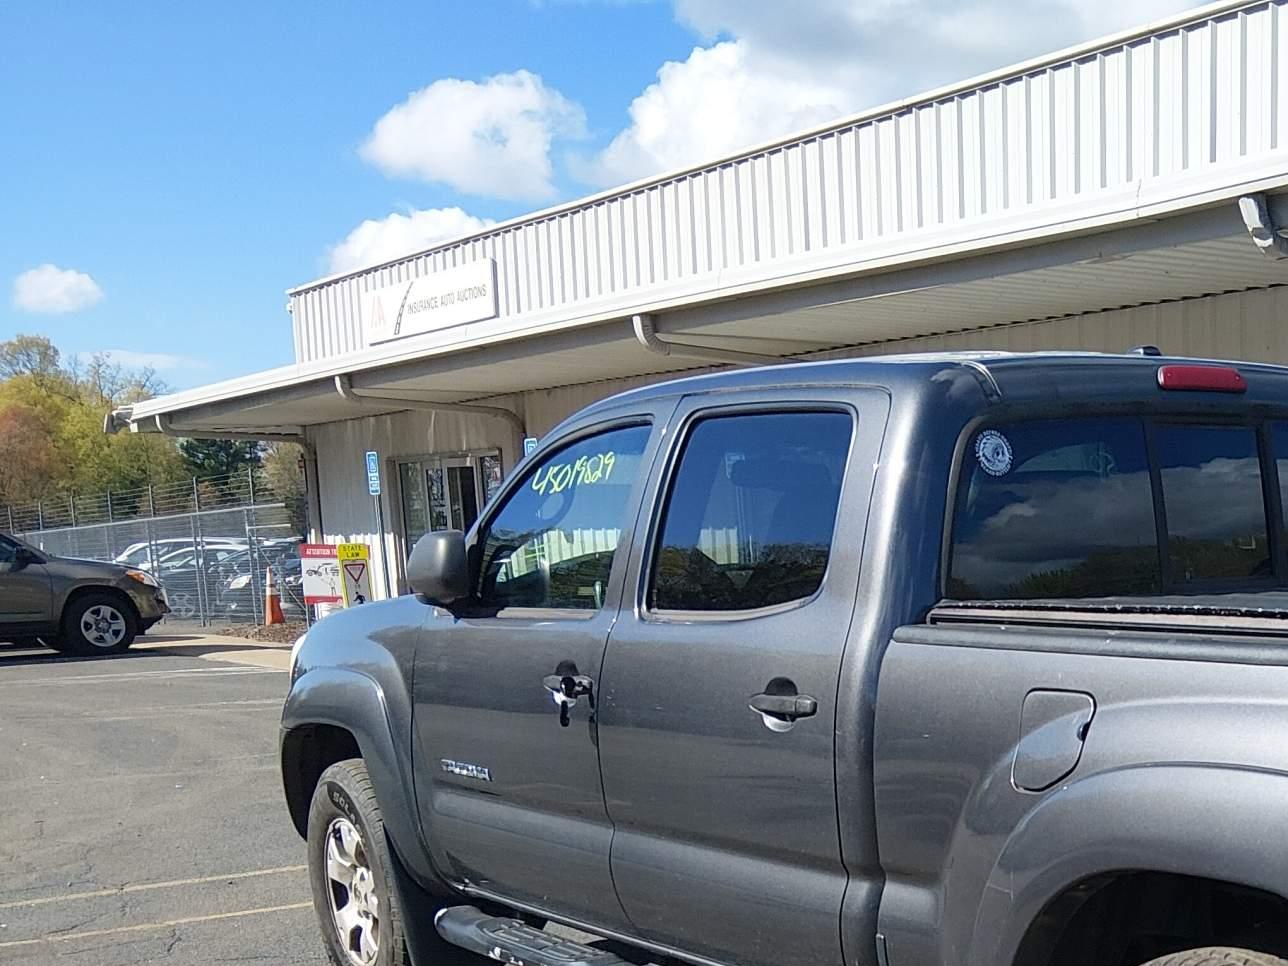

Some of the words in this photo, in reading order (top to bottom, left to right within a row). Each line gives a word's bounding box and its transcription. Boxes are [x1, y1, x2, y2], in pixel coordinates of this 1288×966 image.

[407, 296, 439, 315] INSURANCE
[440, 292, 455, 306] AUTO
[457, 284, 487, 302] AUCTIONS
[531, 451, 616, 496] 45019829
